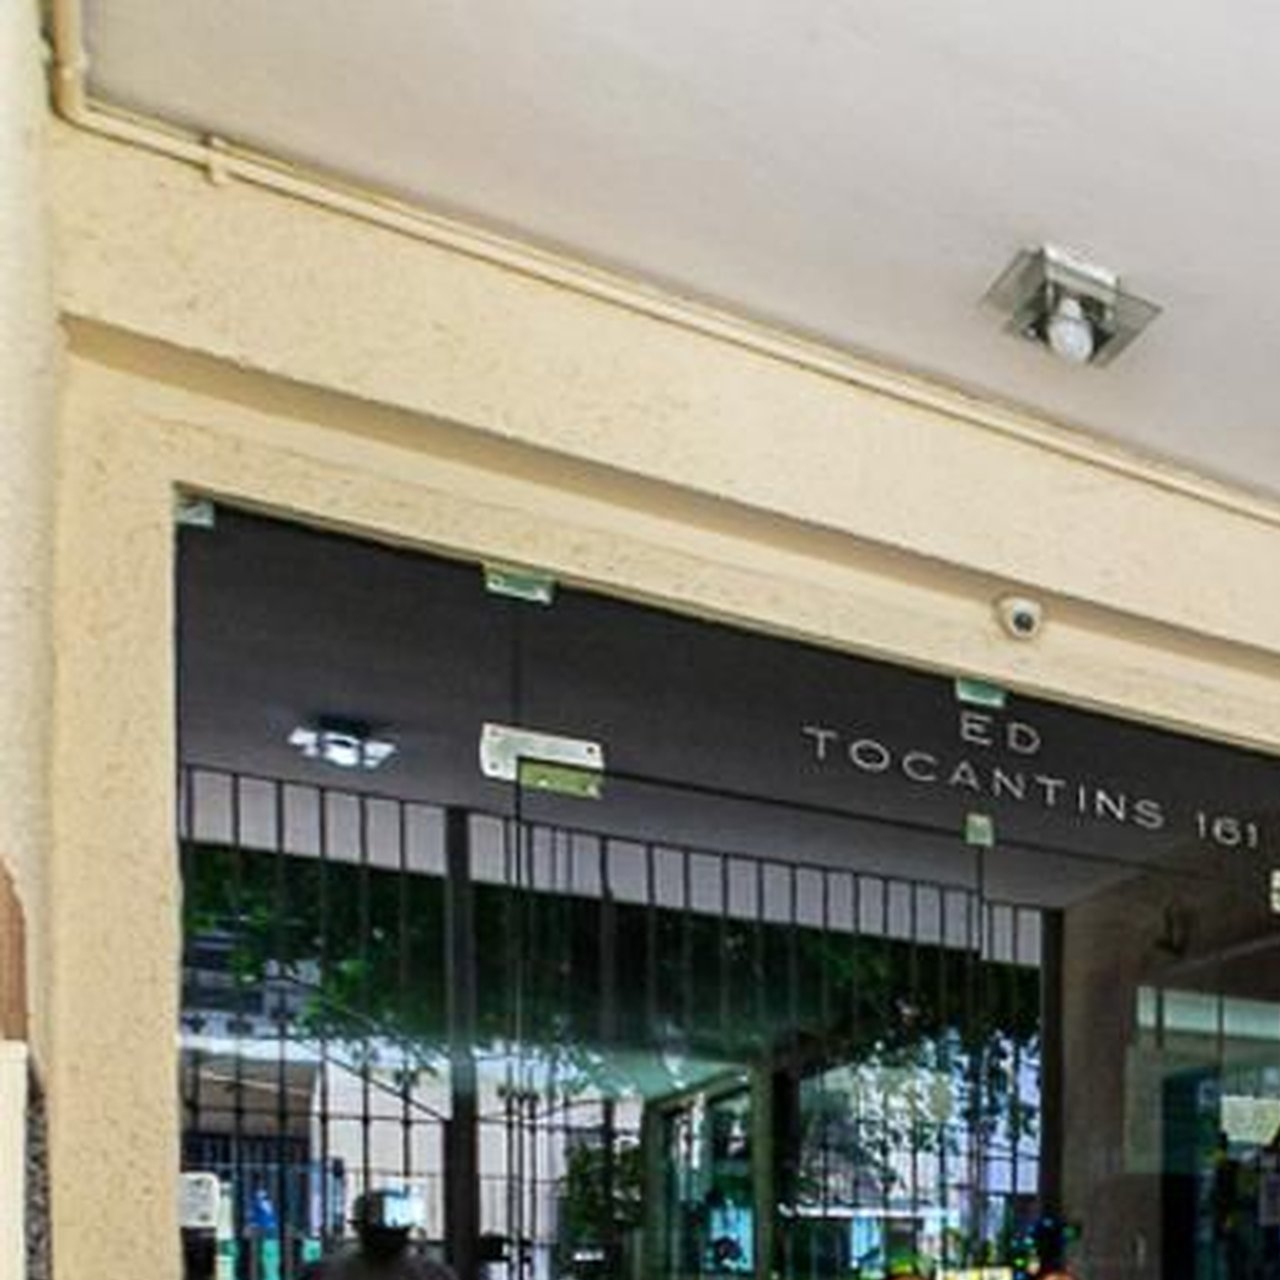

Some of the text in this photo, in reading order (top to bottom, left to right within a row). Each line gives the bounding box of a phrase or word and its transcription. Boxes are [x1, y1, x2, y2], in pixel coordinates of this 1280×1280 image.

[960, 712, 1041, 755] ED
[803, 726, 1259, 849] TOCANTINS 161
